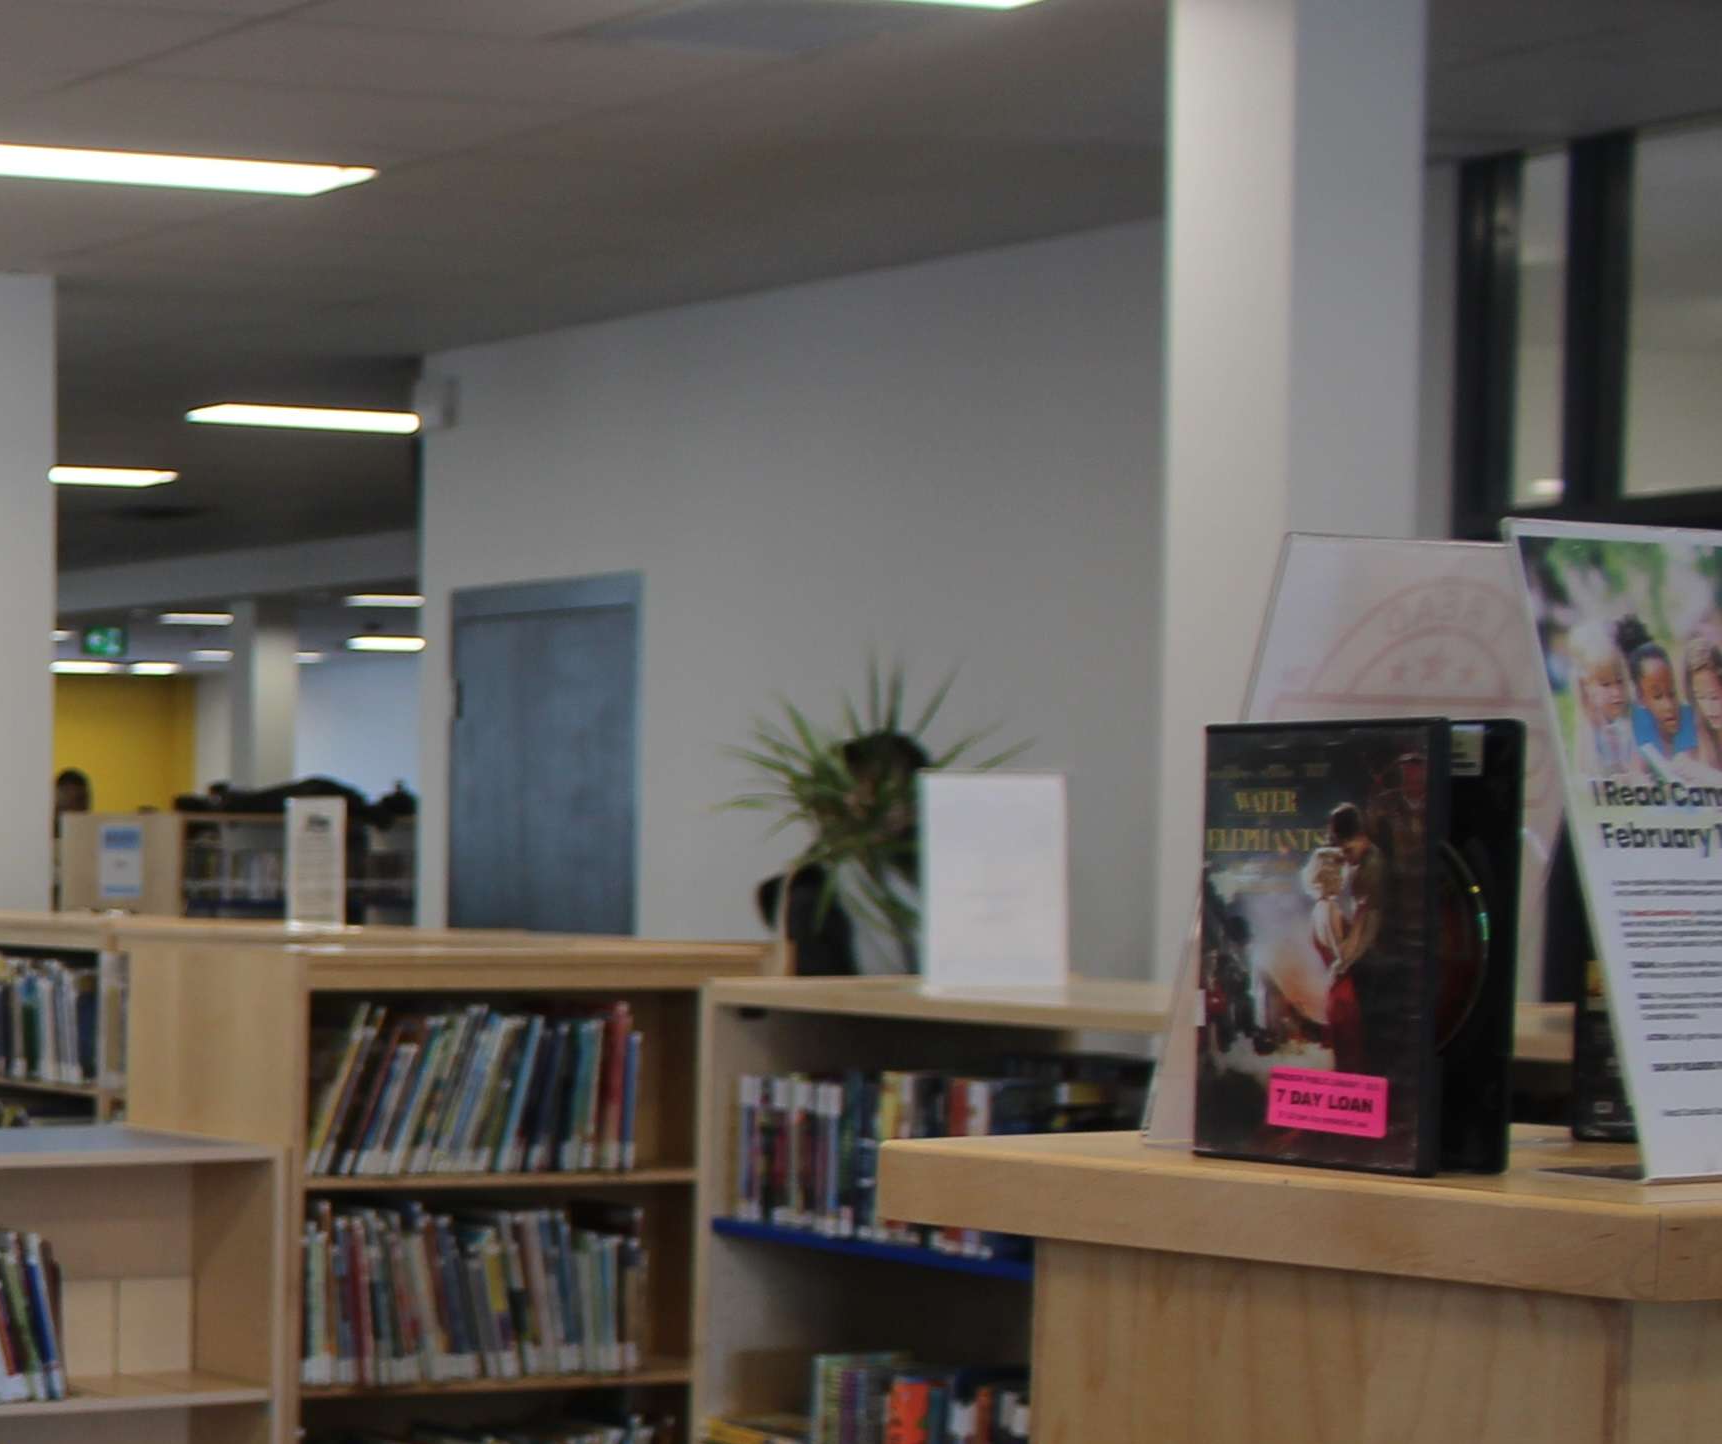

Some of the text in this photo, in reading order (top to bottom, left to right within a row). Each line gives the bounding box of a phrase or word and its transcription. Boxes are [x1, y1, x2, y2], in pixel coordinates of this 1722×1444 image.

[1234, 790, 1298, 813] WATER
[1589, 779, 1722, 807] I Read Can
[1599, 822, 1713, 858] February
[1276, 1088, 1373, 1113] 7 DAY LOAN
